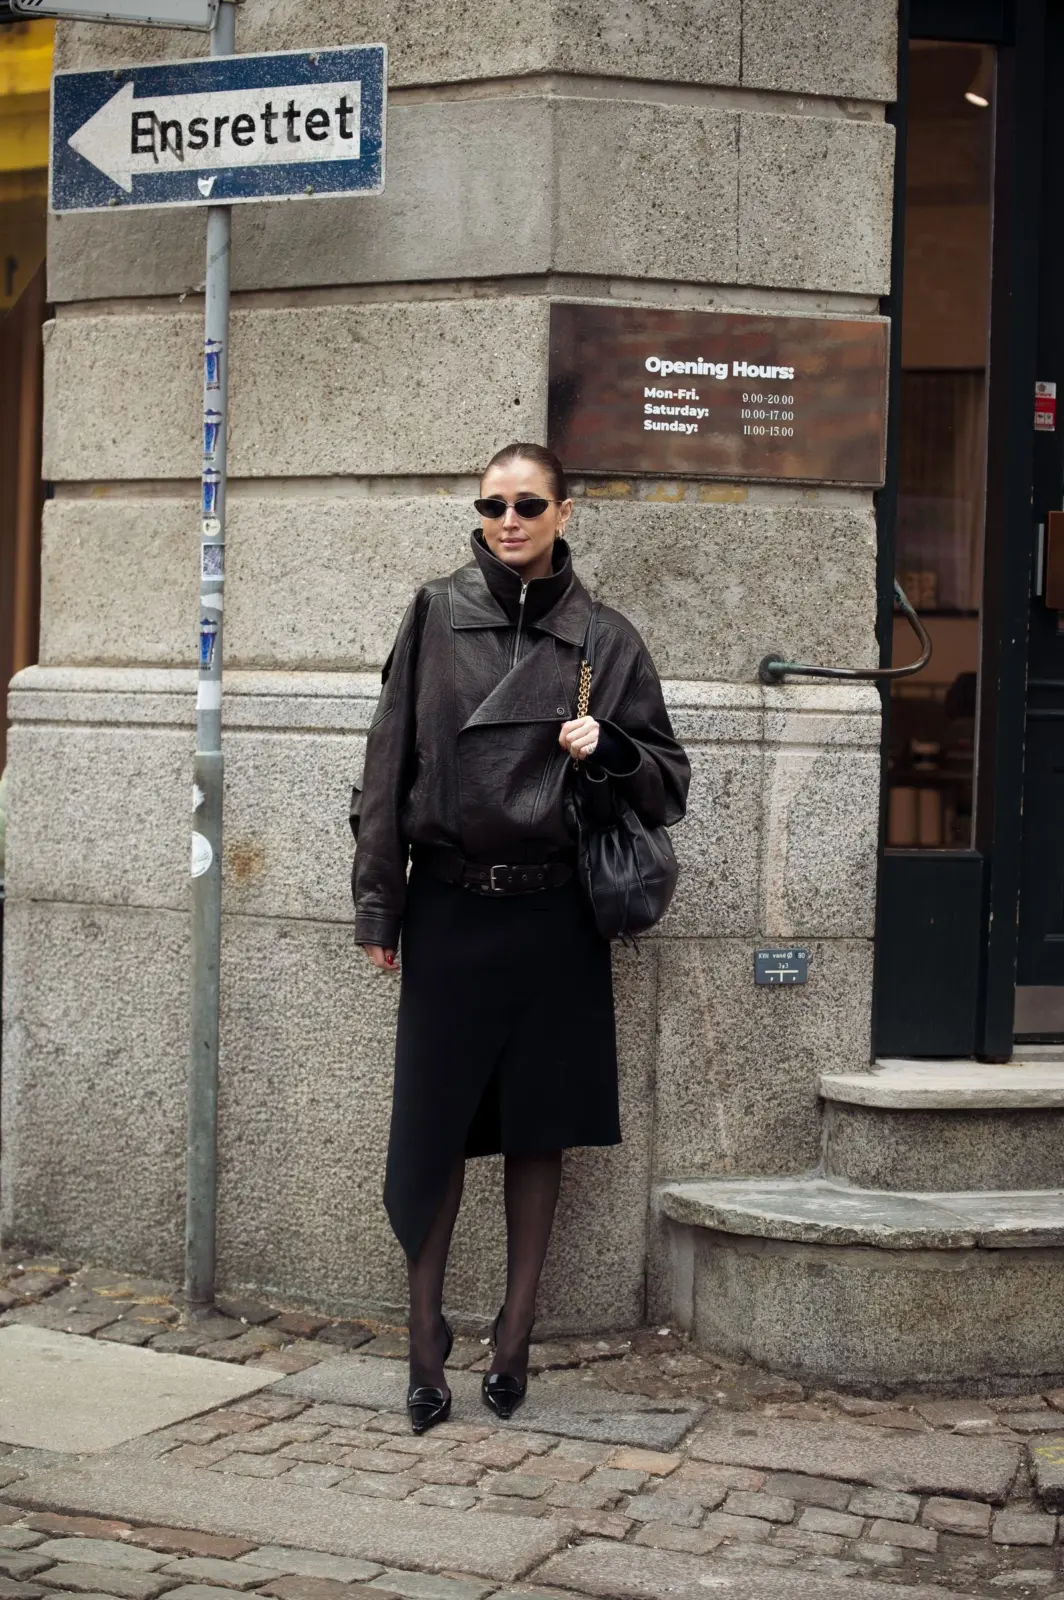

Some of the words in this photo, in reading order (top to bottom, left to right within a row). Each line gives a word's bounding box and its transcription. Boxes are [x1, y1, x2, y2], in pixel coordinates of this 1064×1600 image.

[131, 96, 353, 154] Ensrettet
[645, 356, 728, 379] Opening
[732, 361, 795, 380] Hours:
[644, 387, 700, 401] Mon-Fri.
[742, 393, 794, 404] 9.00-20.00
[644, 403, 709, 419] Saturday:
[741, 409, 794, 421] 10.00-17.00
[643, 419, 698, 435] Sunday:
[743, 425, 794, 437] 11.00-15.00
